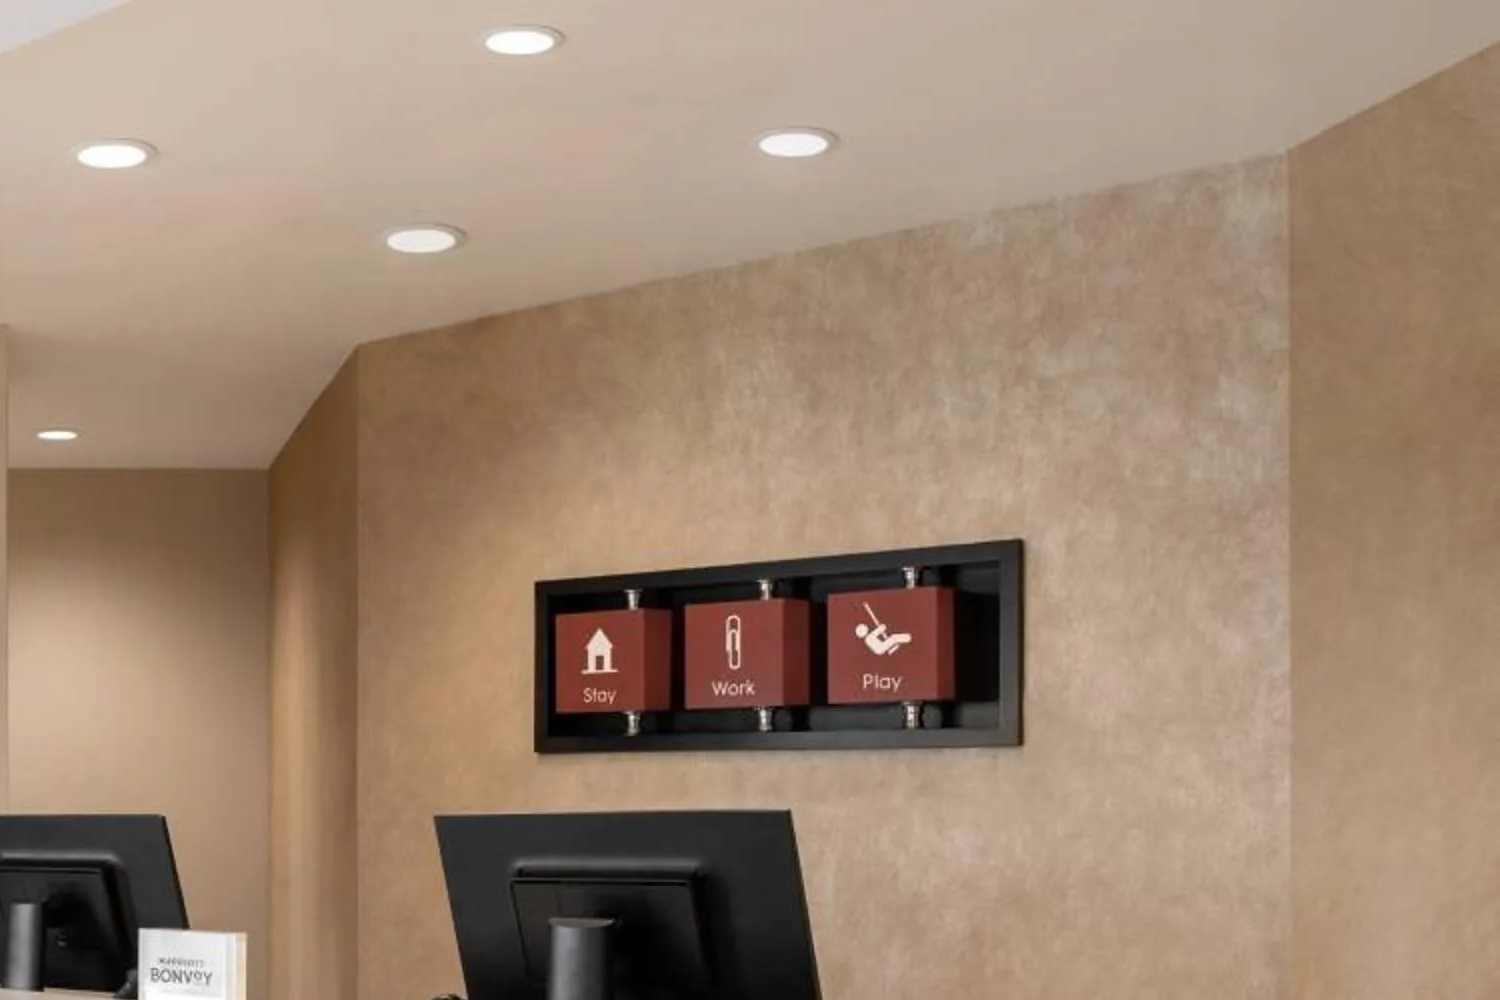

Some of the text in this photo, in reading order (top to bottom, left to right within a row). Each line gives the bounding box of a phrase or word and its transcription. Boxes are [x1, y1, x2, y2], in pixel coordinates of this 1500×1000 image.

[711, 679, 756, 697] Work
[862, 673, 902, 692] Play
[583, 687, 617, 706] Stay
[150, 966, 213, 986] BONVOY
